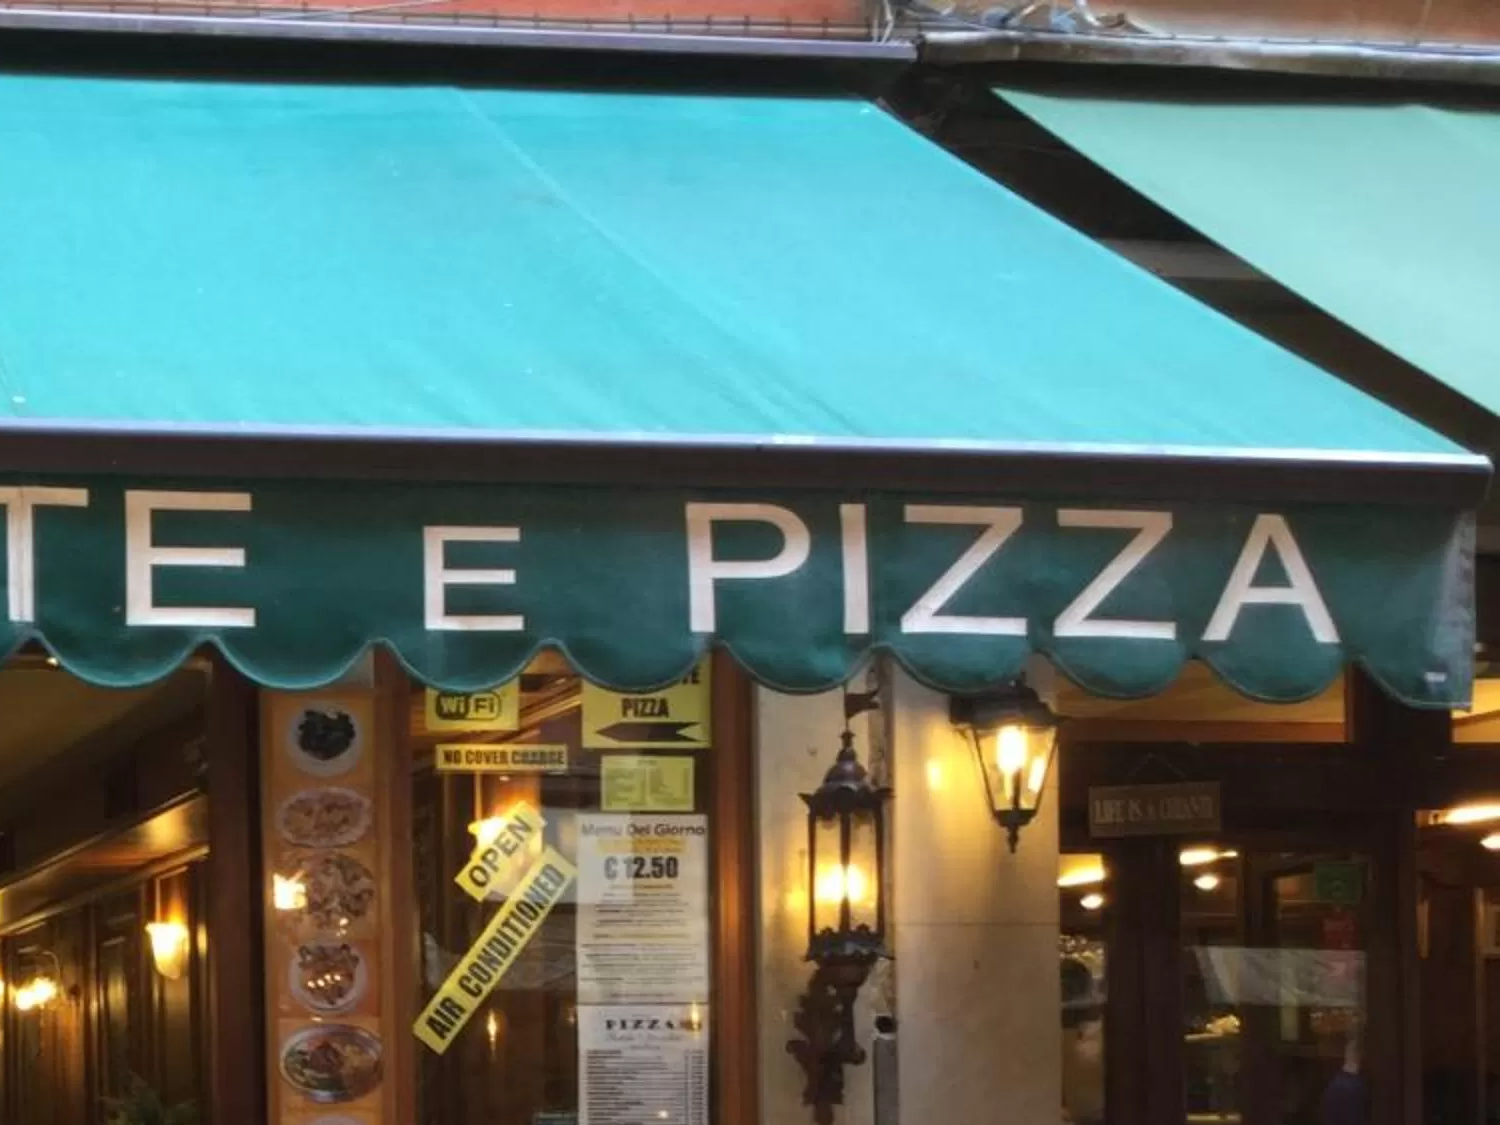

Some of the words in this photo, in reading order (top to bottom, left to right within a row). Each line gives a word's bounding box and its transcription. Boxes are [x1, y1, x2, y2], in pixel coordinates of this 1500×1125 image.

[424, 526, 524, 630] E
[685, 502, 1341, 643] PIZZA
[621, 698, 669, 718] PIZZA
[443, 751, 461, 765] NO
[466, 751, 509, 765] COVER
[654, 824, 706, 836] Giorno
[468, 814, 533, 888] OPEN
[623, 856, 679, 879] 12.50
[425, 996, 466, 1041] AIR
[458, 863, 566, 998] CONDITIONED
